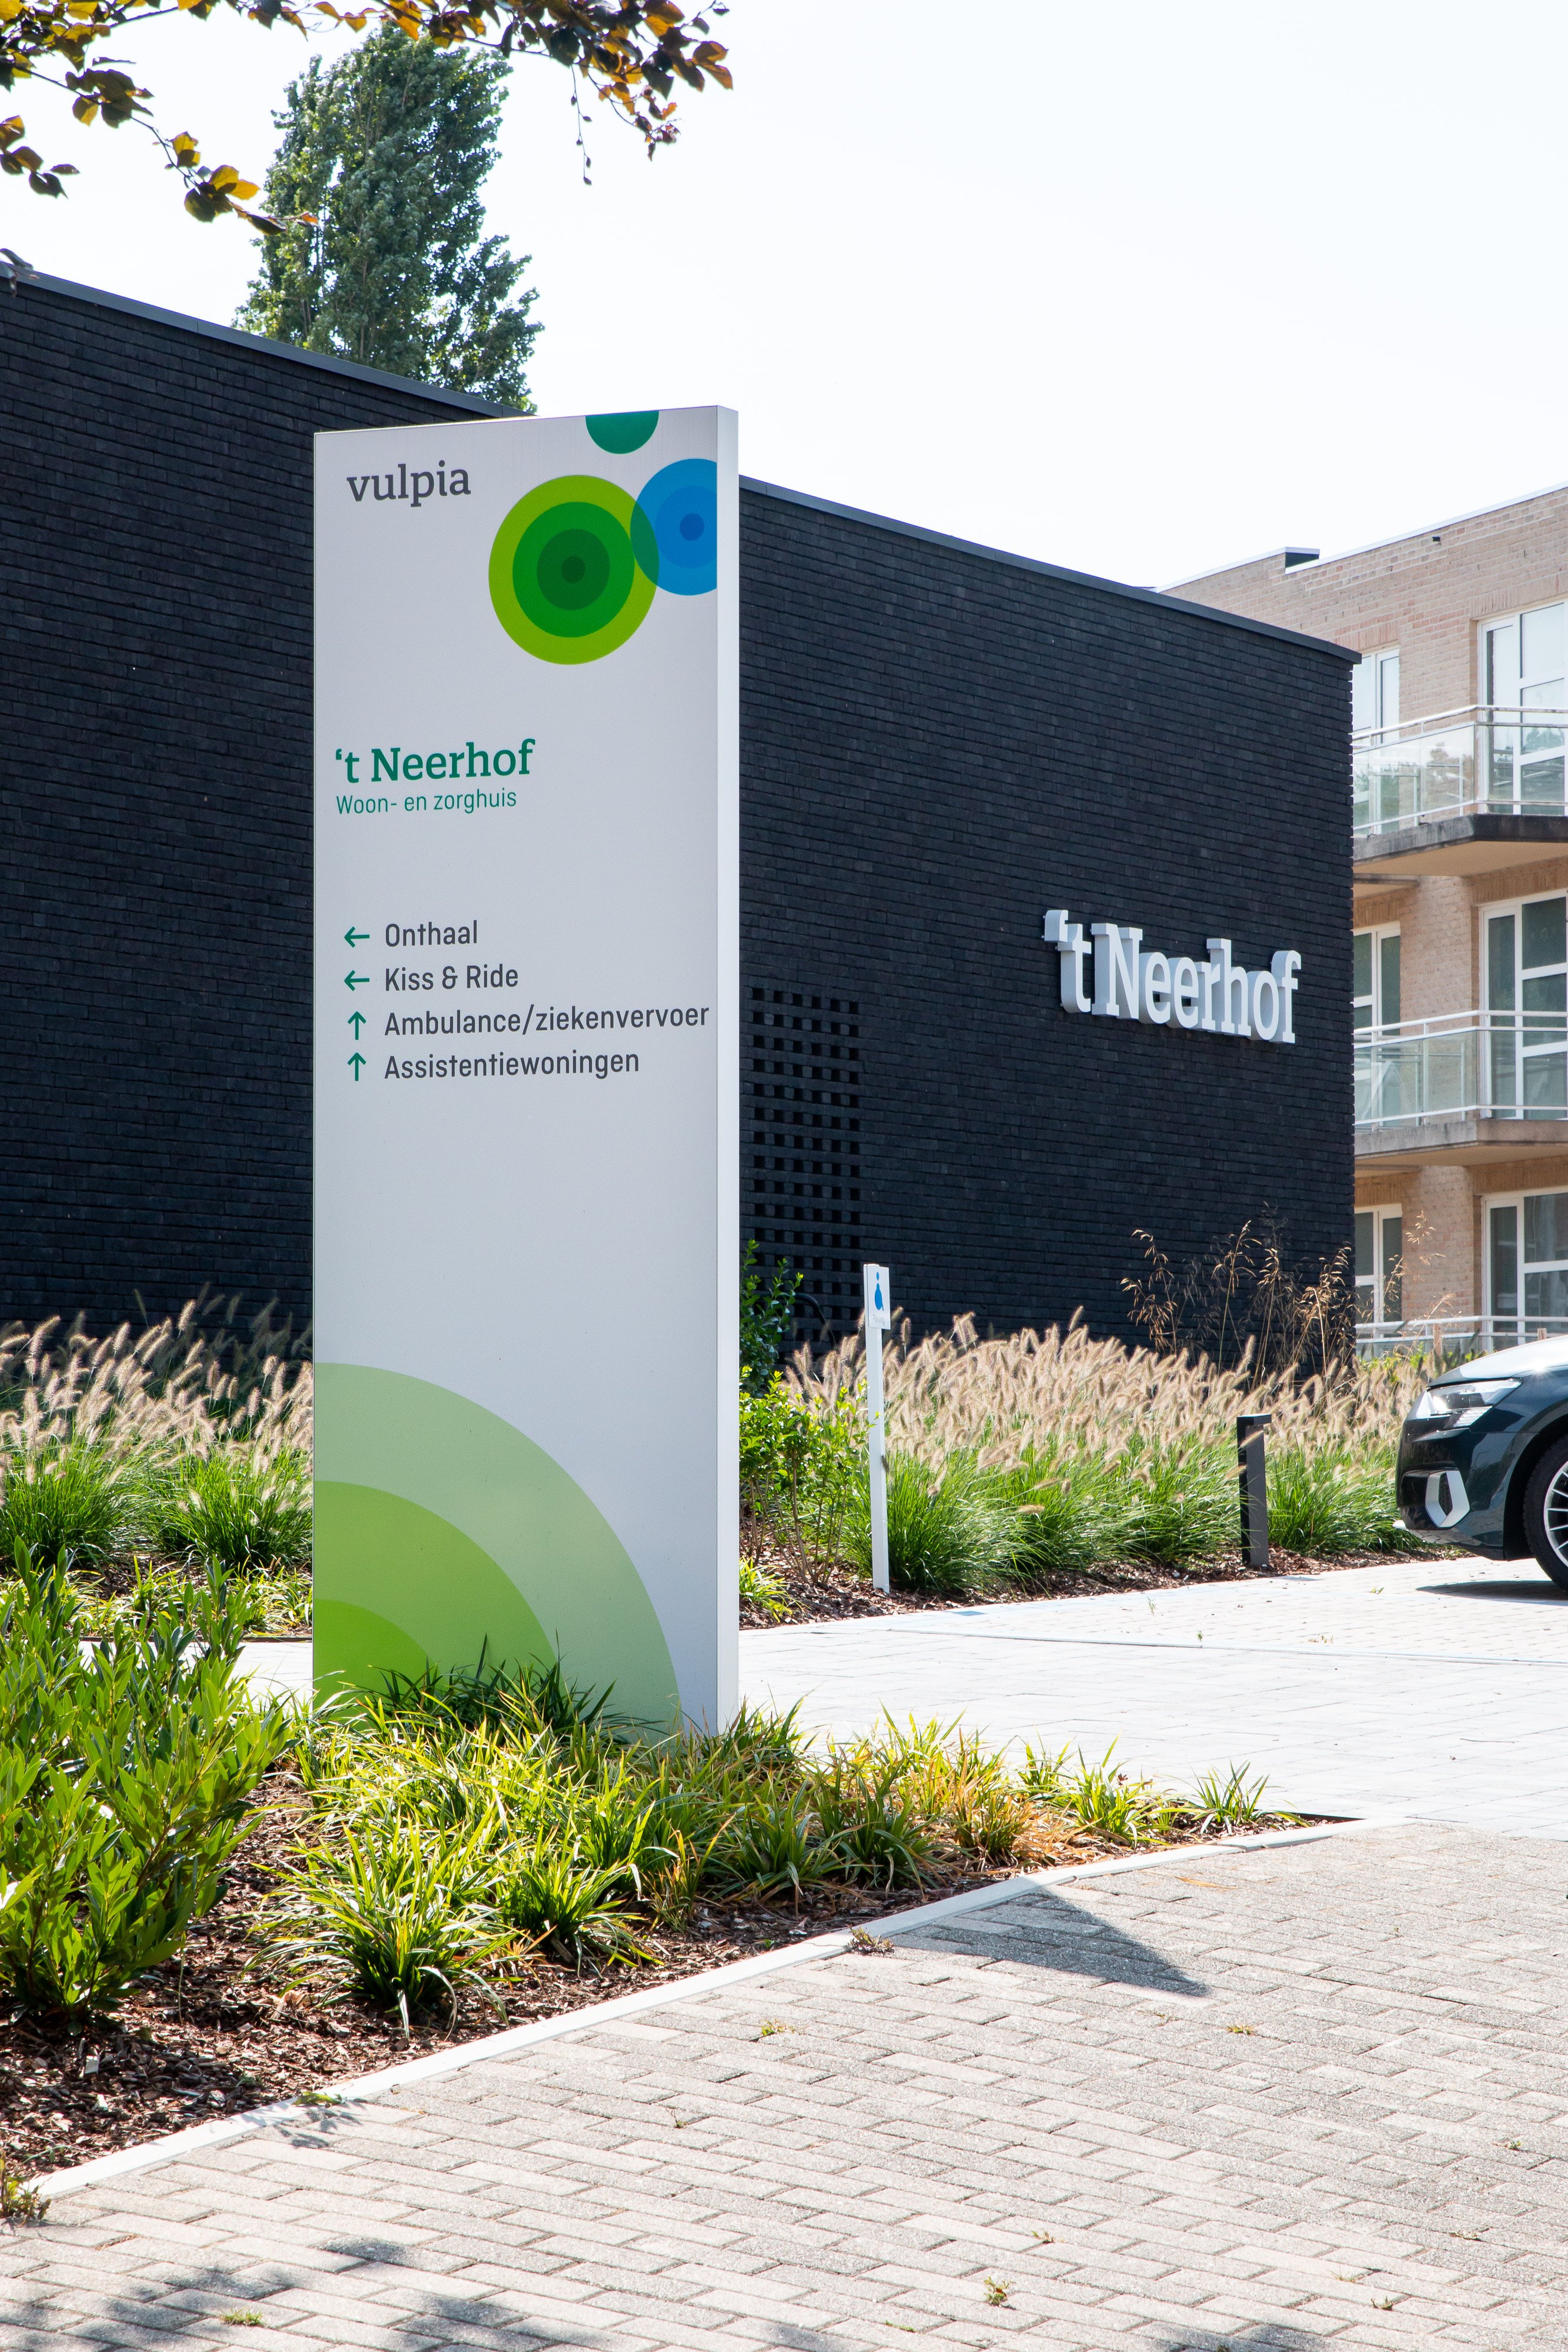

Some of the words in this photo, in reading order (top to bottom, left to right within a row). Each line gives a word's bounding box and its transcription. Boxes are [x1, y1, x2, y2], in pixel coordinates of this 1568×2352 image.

[347, 460, 471, 507] vulpia
[372, 739, 536, 781] Neerhof
[336, 795, 397, 814] Woon-
[404, 796, 427, 811] en
[434, 788, 516, 814] zorghuis
[385, 920, 477, 947] Onthaal
[385, 967, 434, 991] Kiss
[442, 966, 458, 989] &
[467, 964, 518, 988] Ride
[1091, 923, 1301, 1043] Neerhof
[385, 1004, 709, 1036] Ambulance/ziekenvervoer
[385, 1050, 638, 1080] Assistentiewoningen
